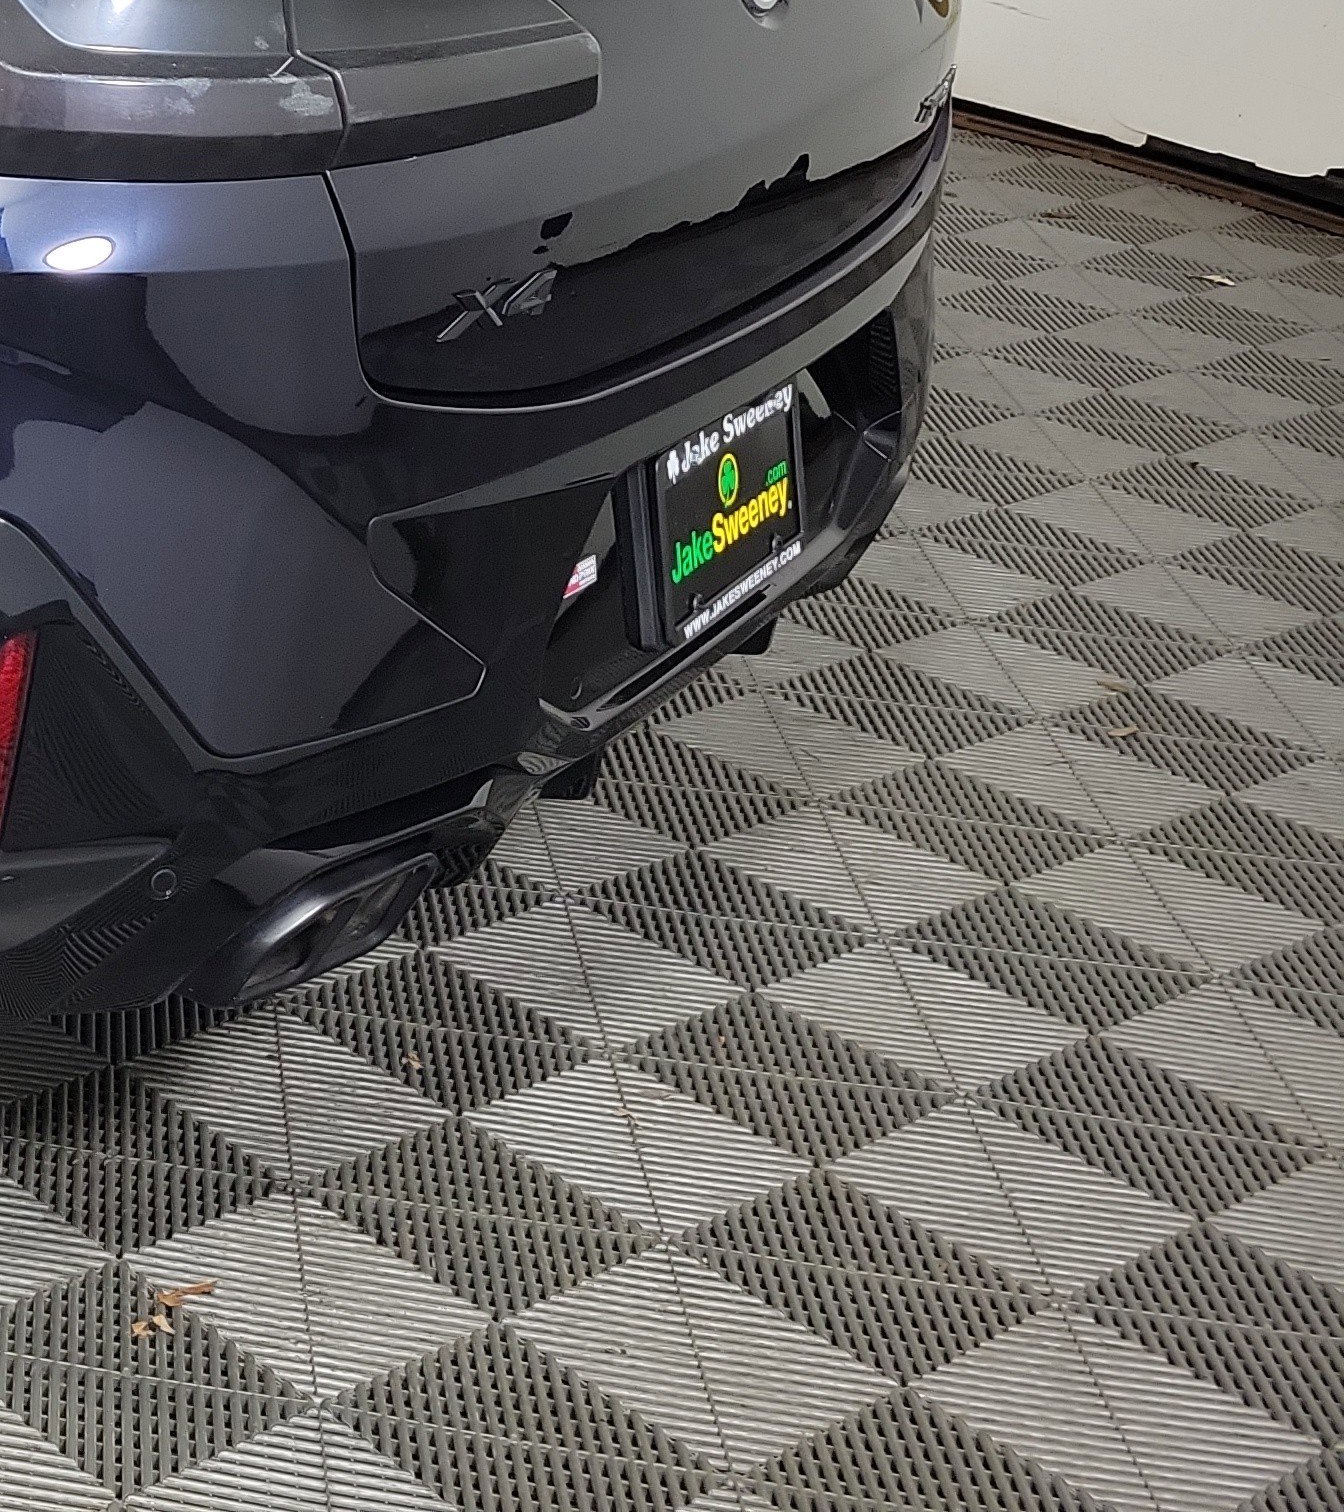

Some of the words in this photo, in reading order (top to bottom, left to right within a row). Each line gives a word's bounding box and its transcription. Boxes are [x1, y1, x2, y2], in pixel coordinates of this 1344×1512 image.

[435, 269, 558, 343] X4
[681, 430, 720, 473] Jake
[765, 460, 788, 486] .com
